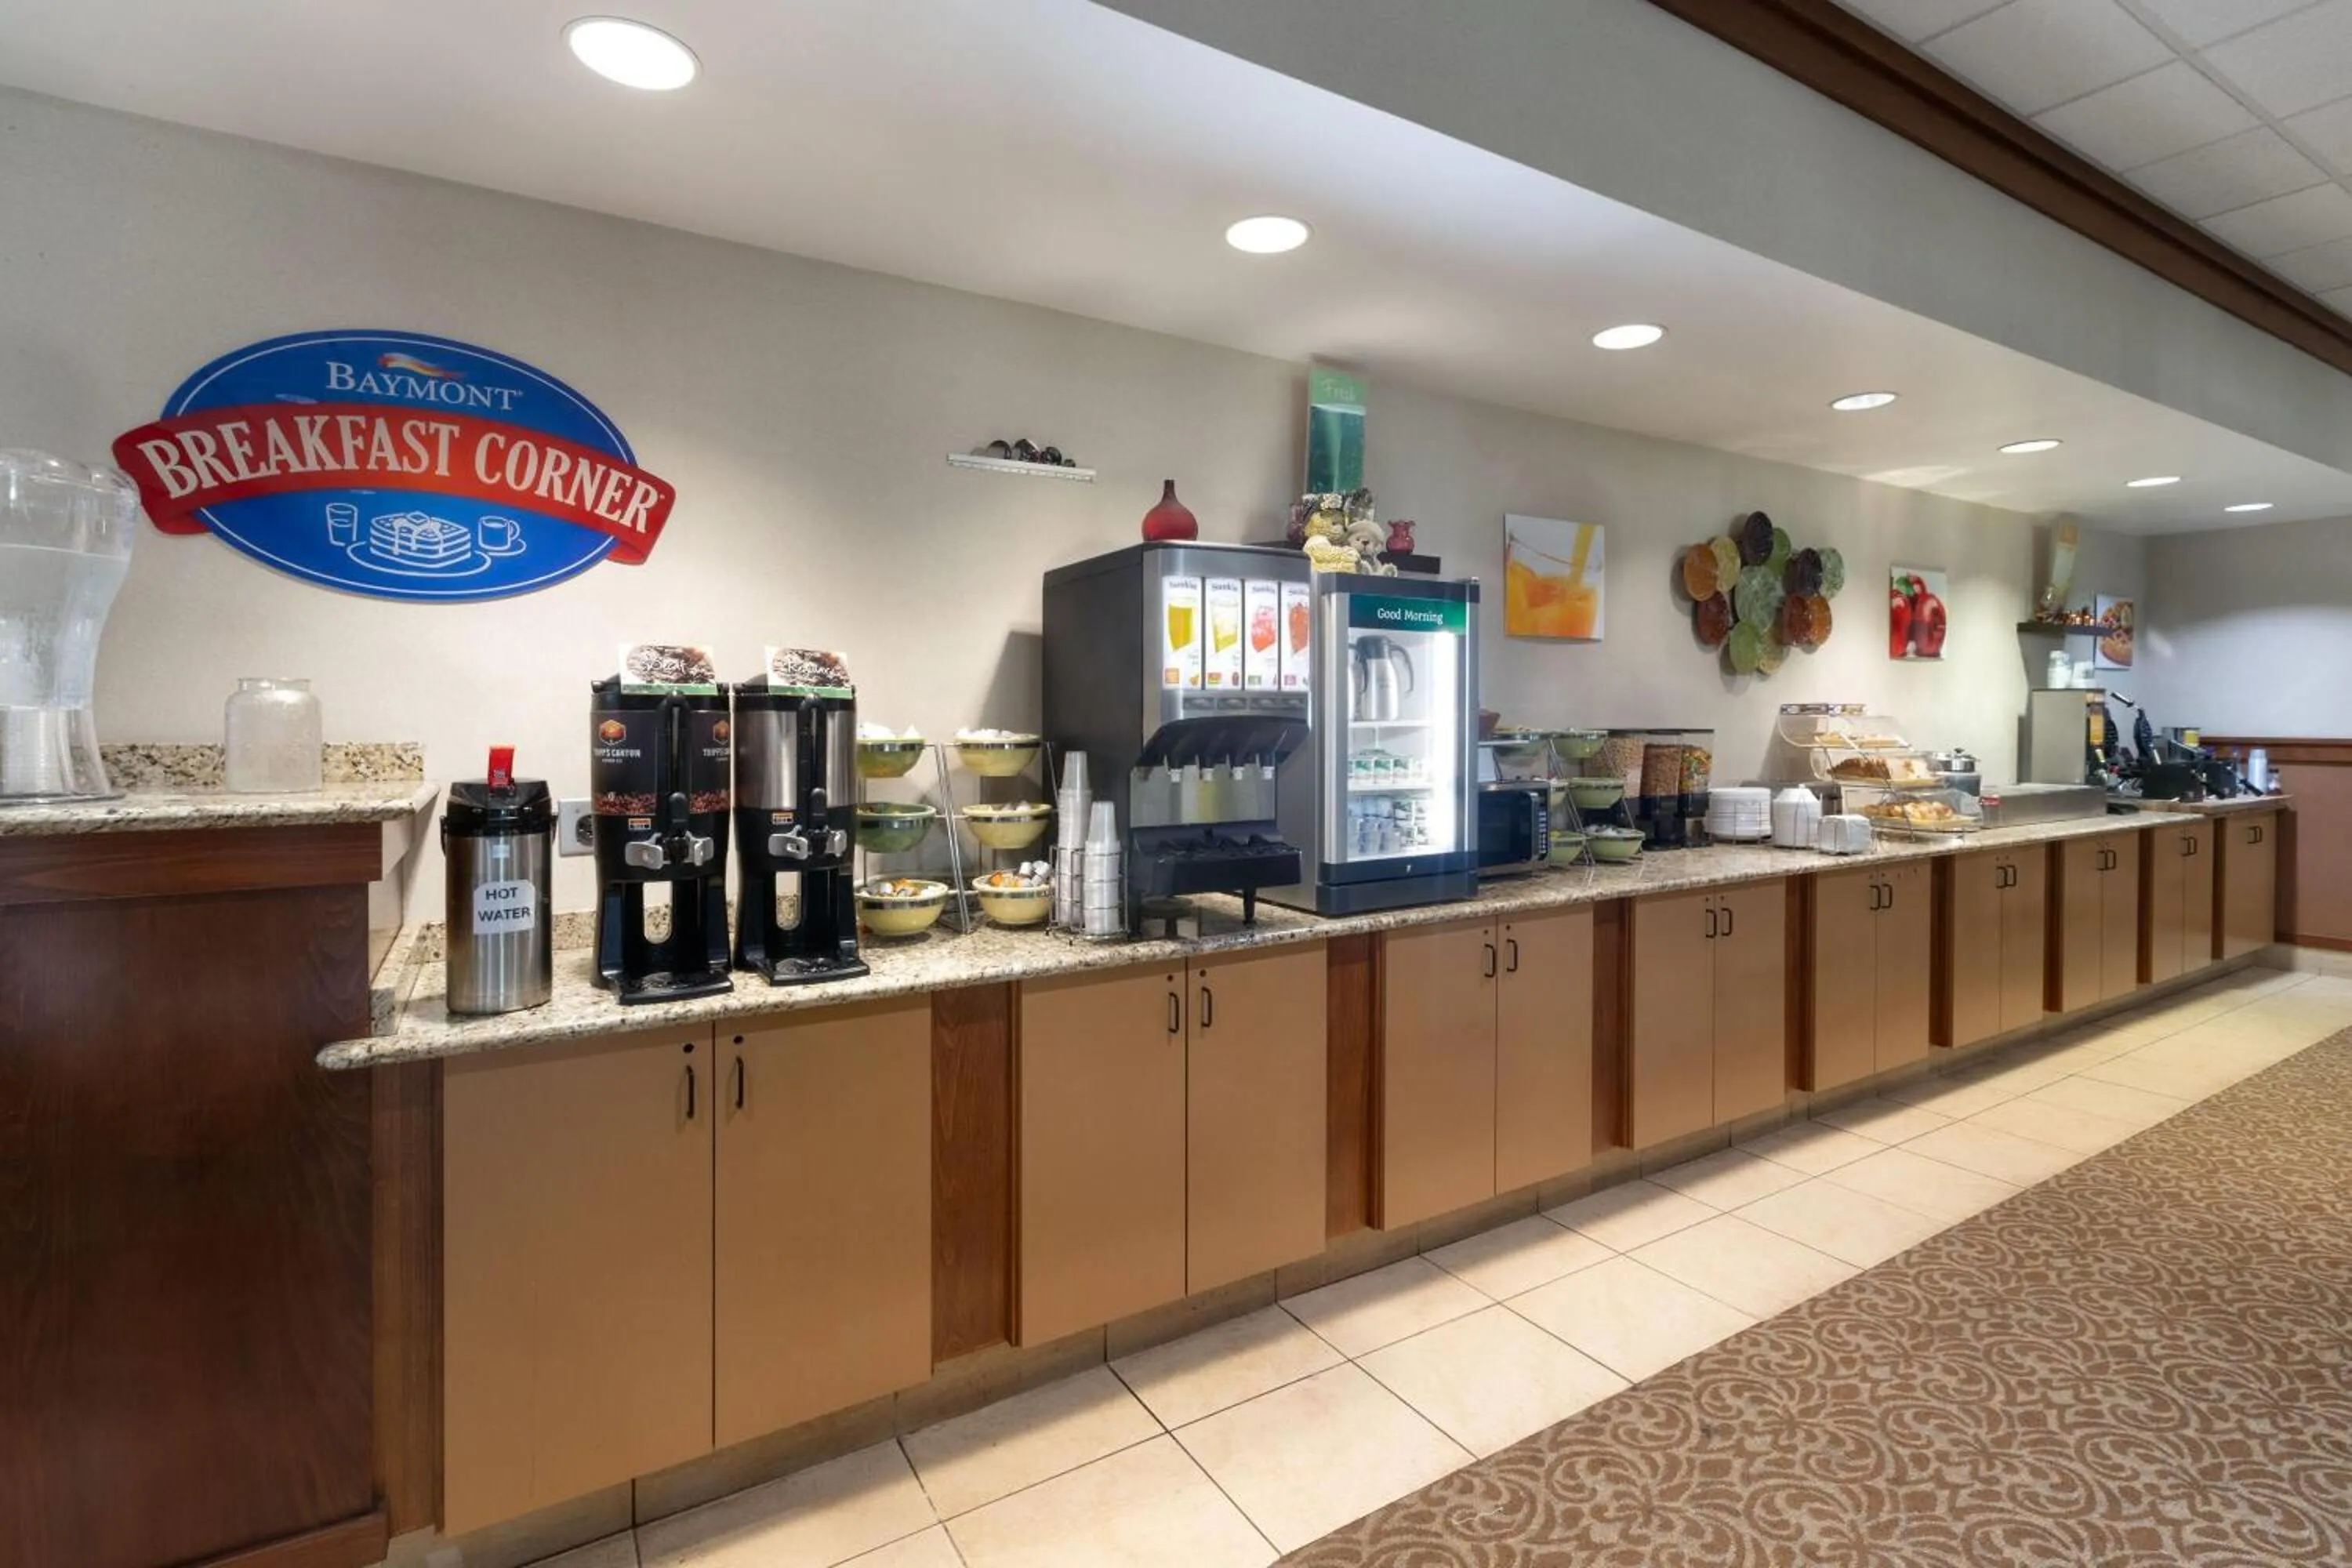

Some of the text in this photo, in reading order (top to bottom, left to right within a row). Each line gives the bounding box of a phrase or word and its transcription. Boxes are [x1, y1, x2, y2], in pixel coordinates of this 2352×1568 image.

[325, 361, 517, 410] BAYMONT
[138, 416, 659, 534] BREAKFAST CORNER
[1377, 608, 1443, 626] Good Morning
[485, 887, 519, 901] HOT
[477, 906, 531, 922] WATER
